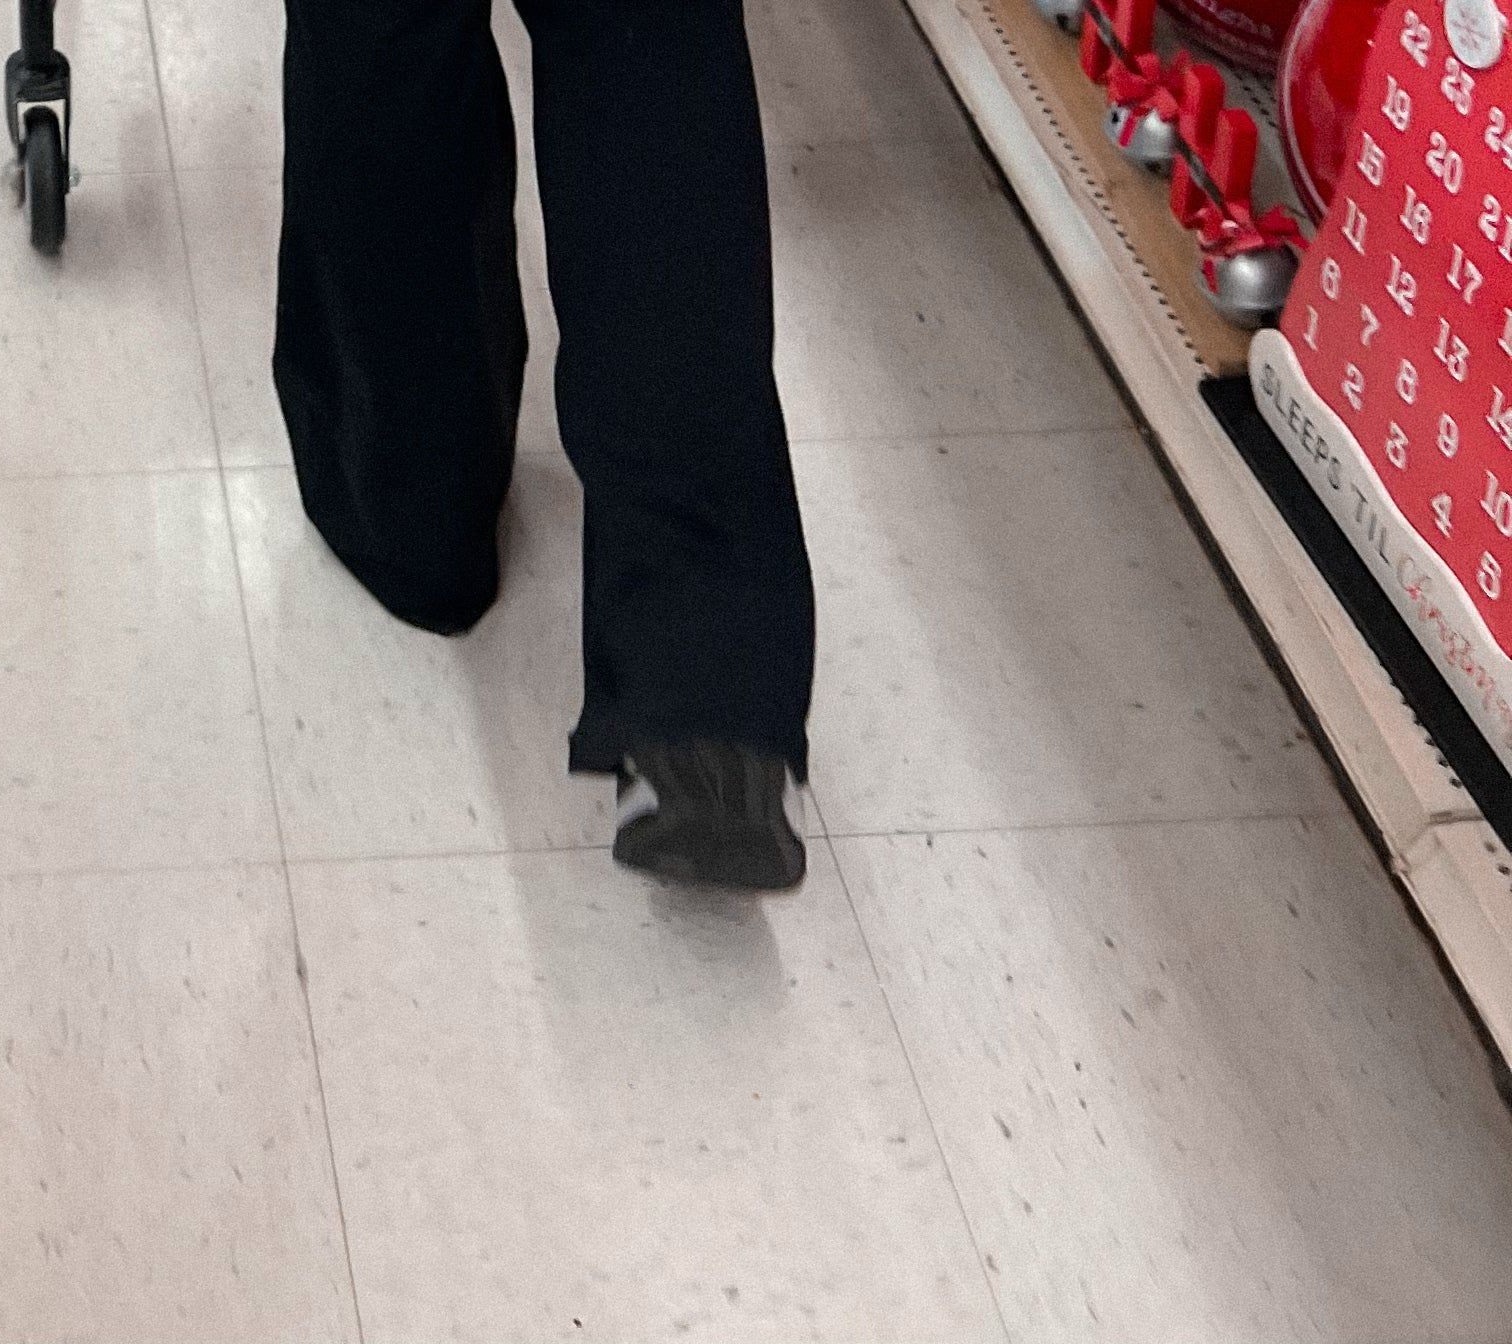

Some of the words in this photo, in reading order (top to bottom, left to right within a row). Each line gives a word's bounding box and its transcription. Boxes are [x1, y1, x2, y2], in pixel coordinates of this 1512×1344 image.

[1426, 131, 1463, 195] 20
[1447, 243, 1483, 305] 17
[1360, 303, 1381, 348] 7
[1303, 304, 1319, 352] 1
[1342, 362, 1365, 412] 2
[1260, 362, 1344, 490] SLEEPS
